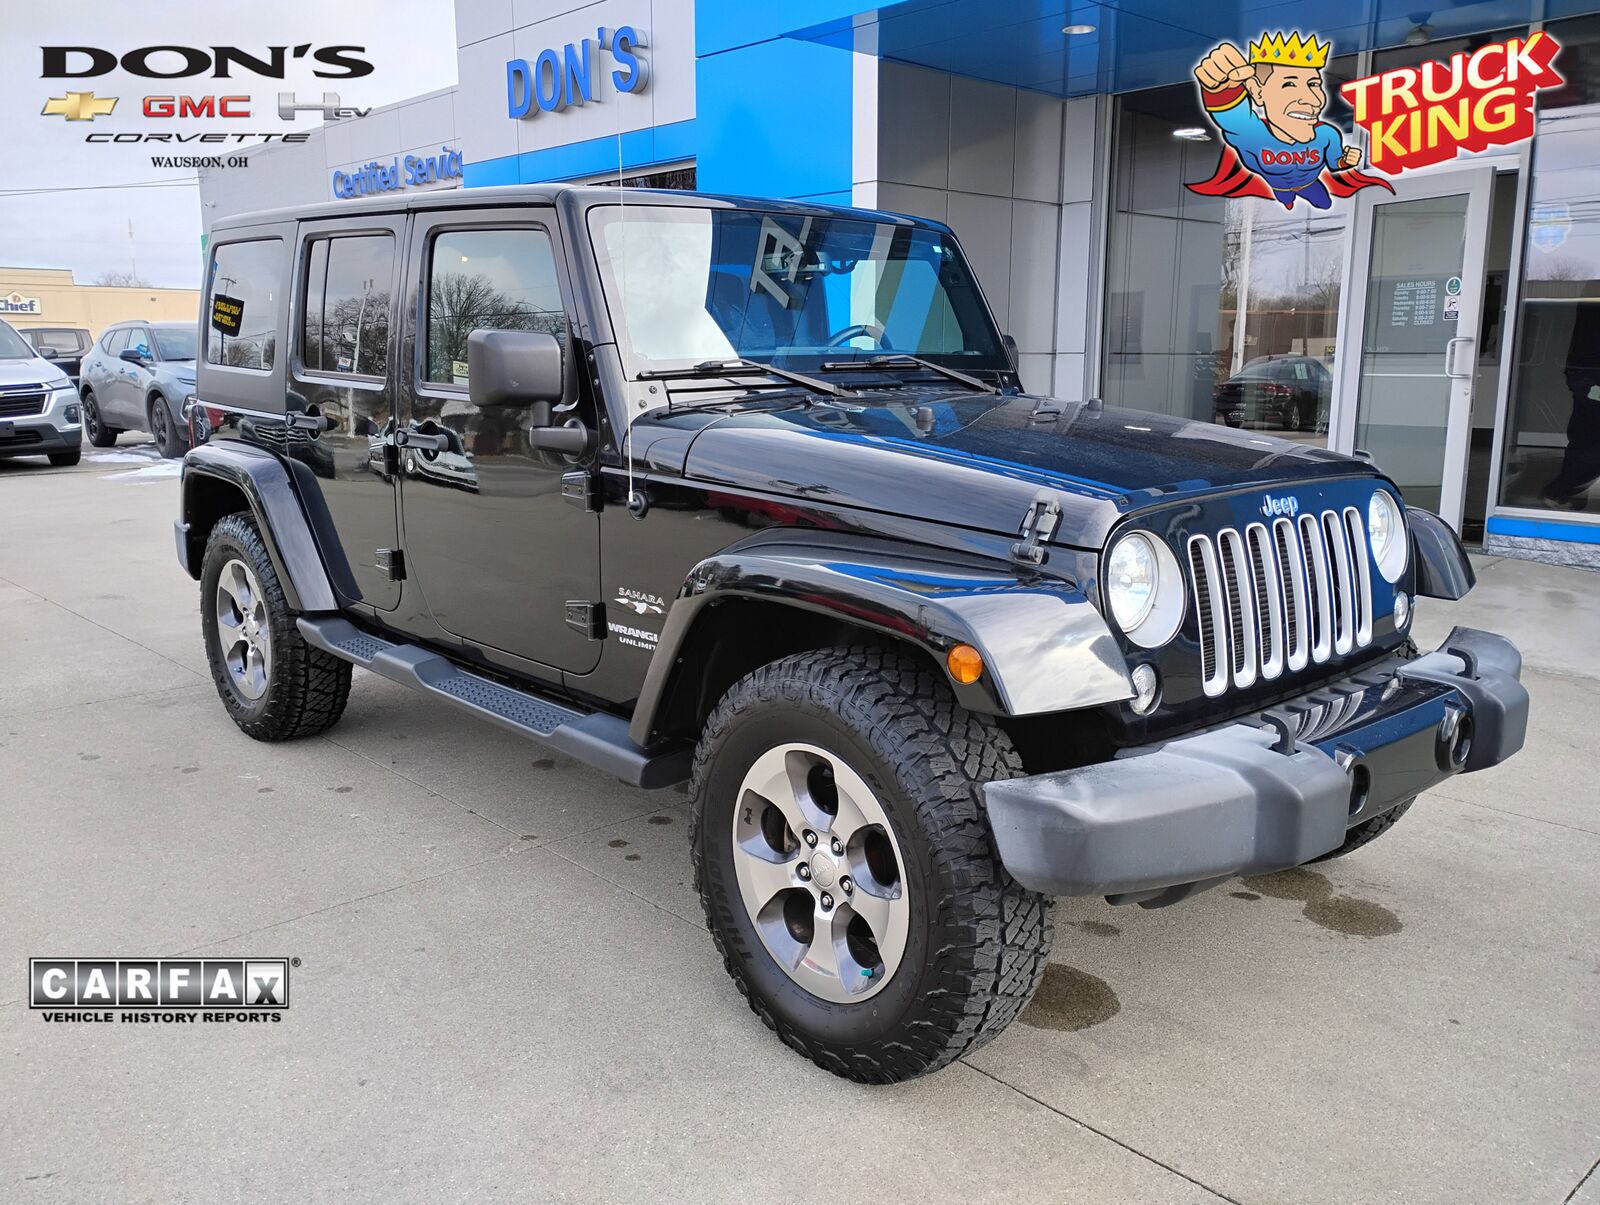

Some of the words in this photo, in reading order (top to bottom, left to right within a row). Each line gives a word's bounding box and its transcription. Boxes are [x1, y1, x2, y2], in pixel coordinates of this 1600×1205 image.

[506, 26, 649, 119] DON'S
[333, 157, 399, 199] Certified
[1260, 494, 1299, 517] Jeep
[618, 587, 665, 606] SAHARA
